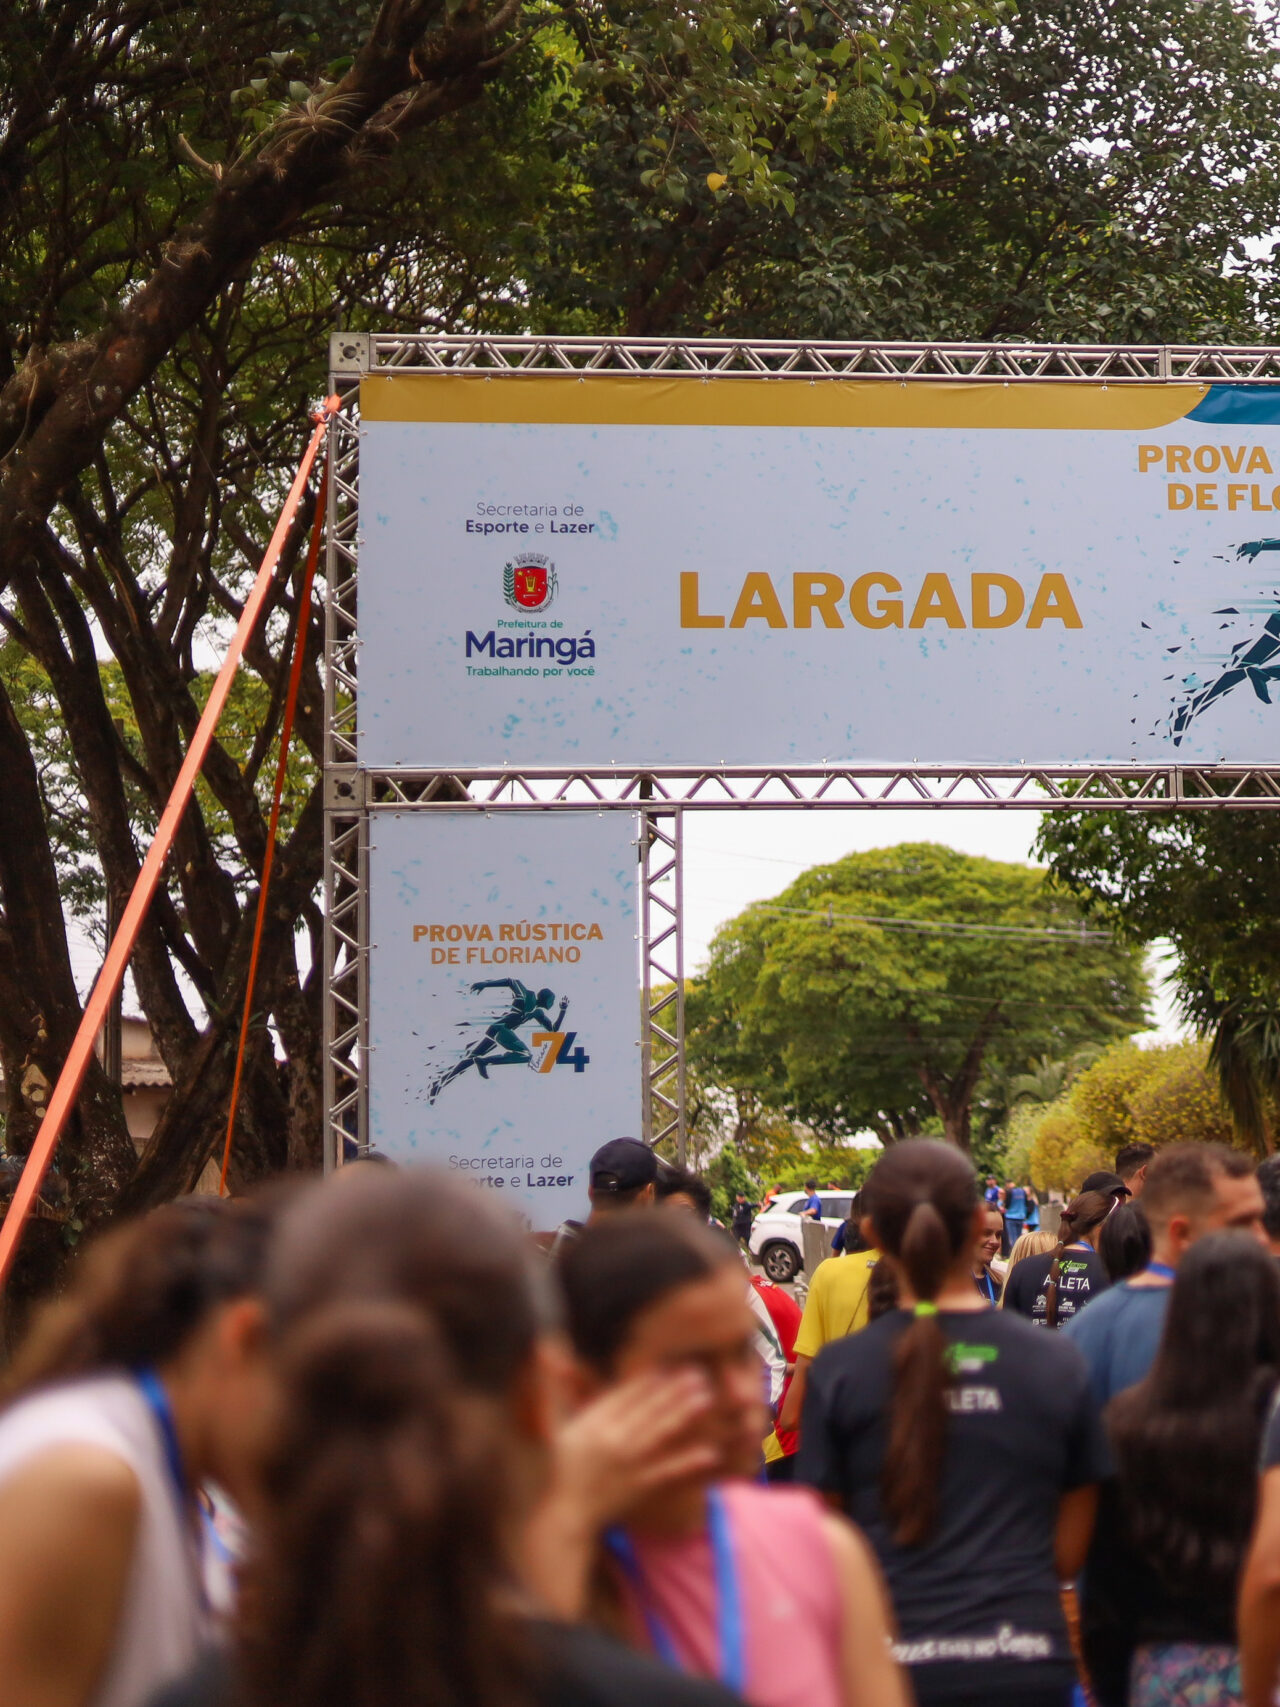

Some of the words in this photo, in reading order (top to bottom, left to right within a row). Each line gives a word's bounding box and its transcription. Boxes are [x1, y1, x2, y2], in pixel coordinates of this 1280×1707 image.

[1138, 445, 1273, 474] PROVA
[1167, 483, 1218, 511] DE
[476, 502, 557, 516] Secretaria
[563, 503, 584, 516] de
[466, 520, 529, 536] Esporte
[535, 523, 545, 534] e
[550, 520, 595, 533] Lazer
[680, 571, 1083, 630] LARGADA
[497, 619, 547, 629] Prefeitura
[550, 619, 564, 629] de
[466, 630, 595, 666] Maringá
[466, 666, 539, 676] Trabalhando
[543, 667, 563, 678] por
[567, 666, 595, 676] você
[413, 924, 493, 942] PROVA
[499, 919, 604, 941] RÚSTICA
[431, 947, 460, 964] DE
[466, 946, 581, 964] FLORIANO
[532, 1031, 590, 1073] 74
[449, 1154, 534, 1170] Secretaria
[540, 1154, 563, 1168] de
[510, 1176, 521, 1188] e
[527, 1173, 574, 1187] Lazer
[1043, 1274, 1090, 1290] ALETA
